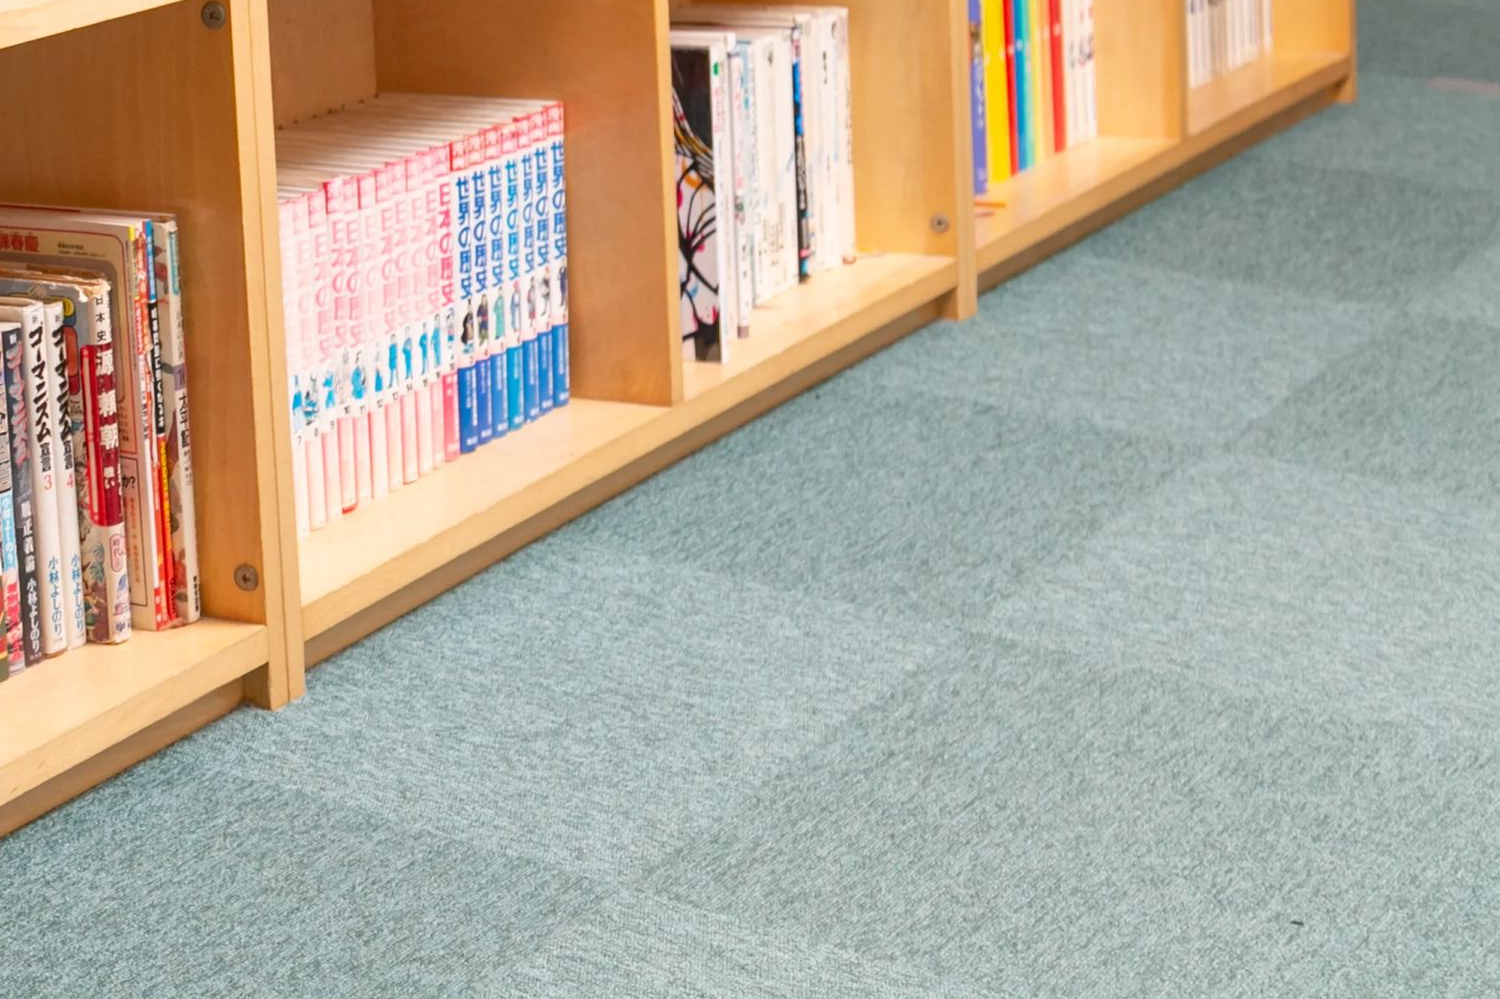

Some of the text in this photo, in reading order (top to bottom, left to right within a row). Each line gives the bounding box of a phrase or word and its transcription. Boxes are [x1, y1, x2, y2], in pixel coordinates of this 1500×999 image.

[29, 323, 63, 635] ゴーマニズム宣言 3 小林よしのり
[66, 474, 74, 489] 4
[70, 553, 84, 634] 小林よしのり
[26, 578, 39, 654] 小林よしのり
